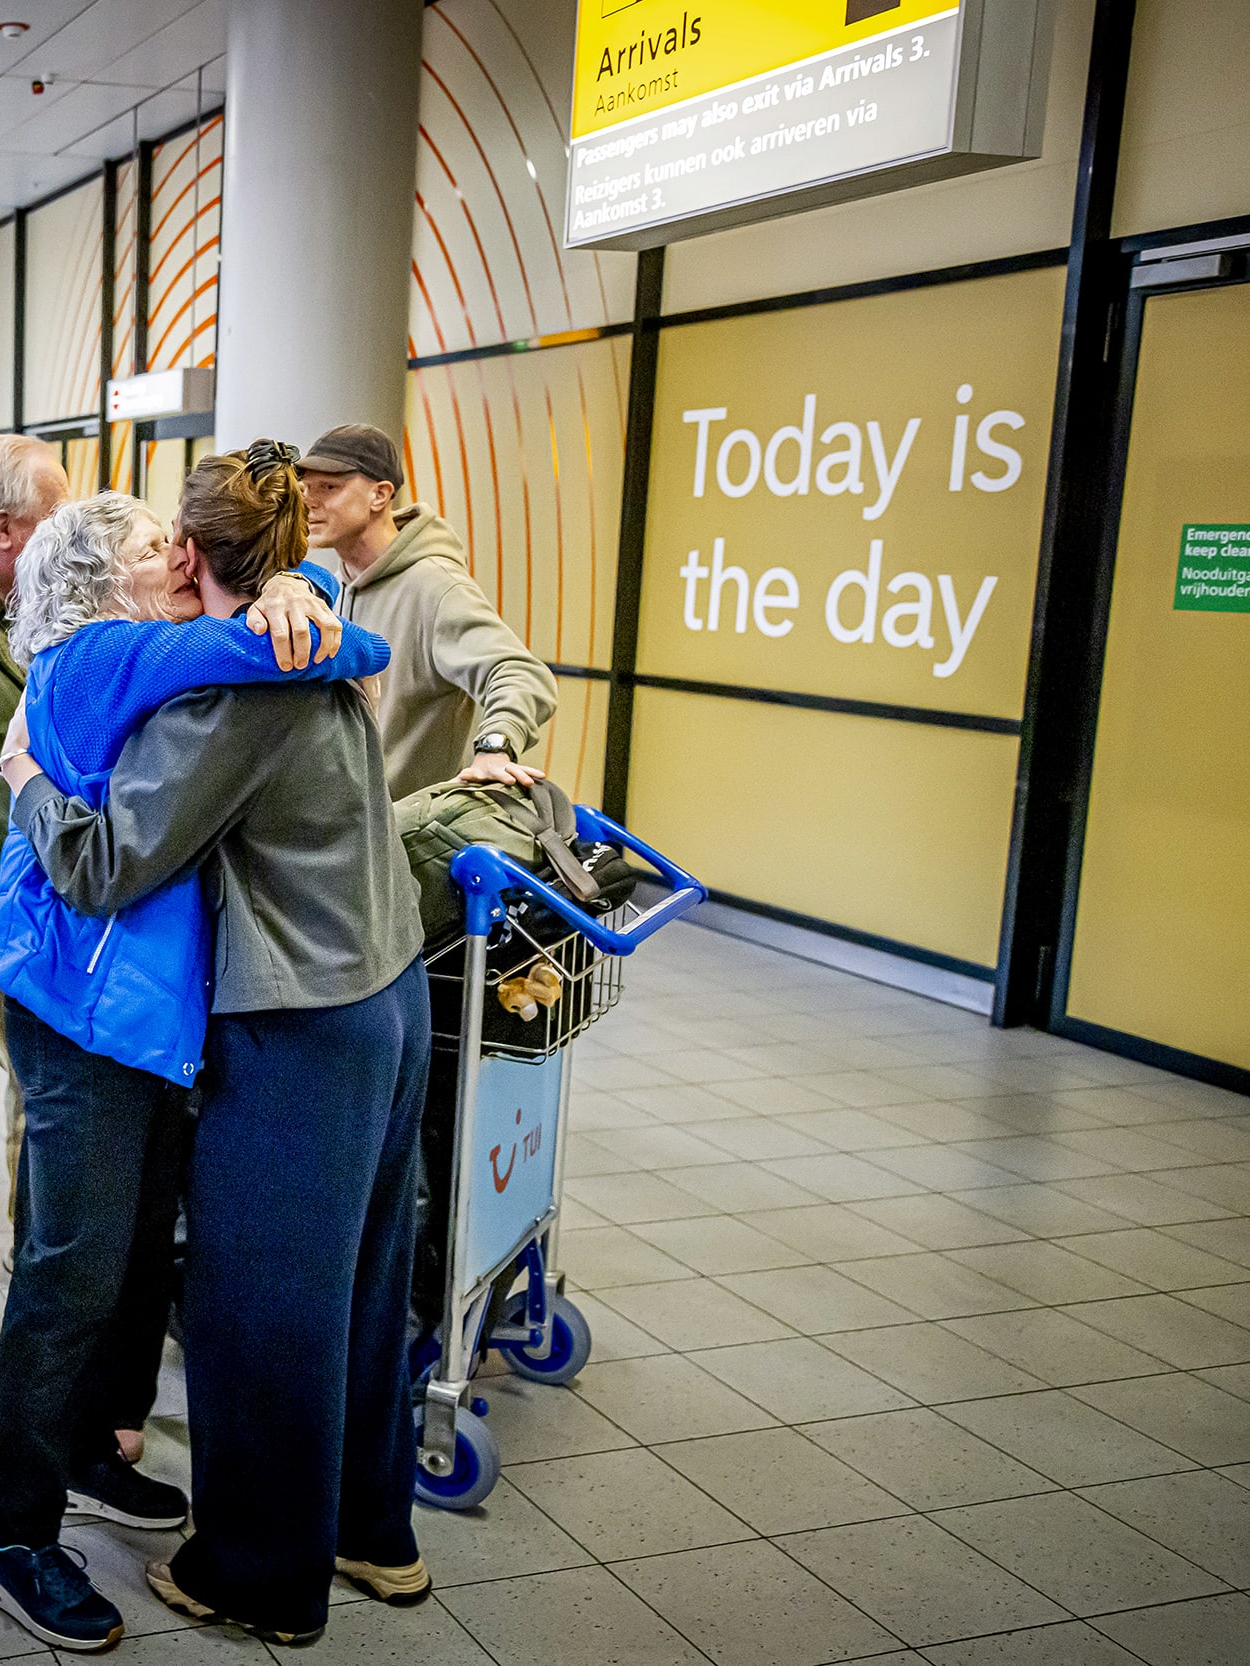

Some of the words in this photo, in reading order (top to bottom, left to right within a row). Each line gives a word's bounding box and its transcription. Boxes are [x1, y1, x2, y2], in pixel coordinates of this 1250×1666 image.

[596, 11, 701, 82] Arrivals
[577, 127, 659, 168] Passengers
[662, 114, 698, 139] may
[701, 101, 738, 127] also
[742, 84, 780, 114] exit
[784, 74, 814, 101] via
[818, 43, 903, 91] Arrivals
[909, 35, 931, 62] 3.
[594, 68, 678, 117] Aankomst
[575, 171, 641, 205] Reizigers
[644, 152, 706, 185] kunnen
[711, 136, 746, 165] ook
[750, 112, 840, 155] arriveren
[846, 99, 878, 127] via
[573, 193, 648, 231] Aankomst
[651, 188, 667, 210] 3.
[682, 394, 922, 521] Today
[949, 384, 1026, 492] is
[1185, 543, 1218, 559] keep
[1220, 543, 1250, 557] clea
[680, 537, 800, 637] the
[825, 539, 998, 678] day
[523, 1123, 542, 1163] TUI
